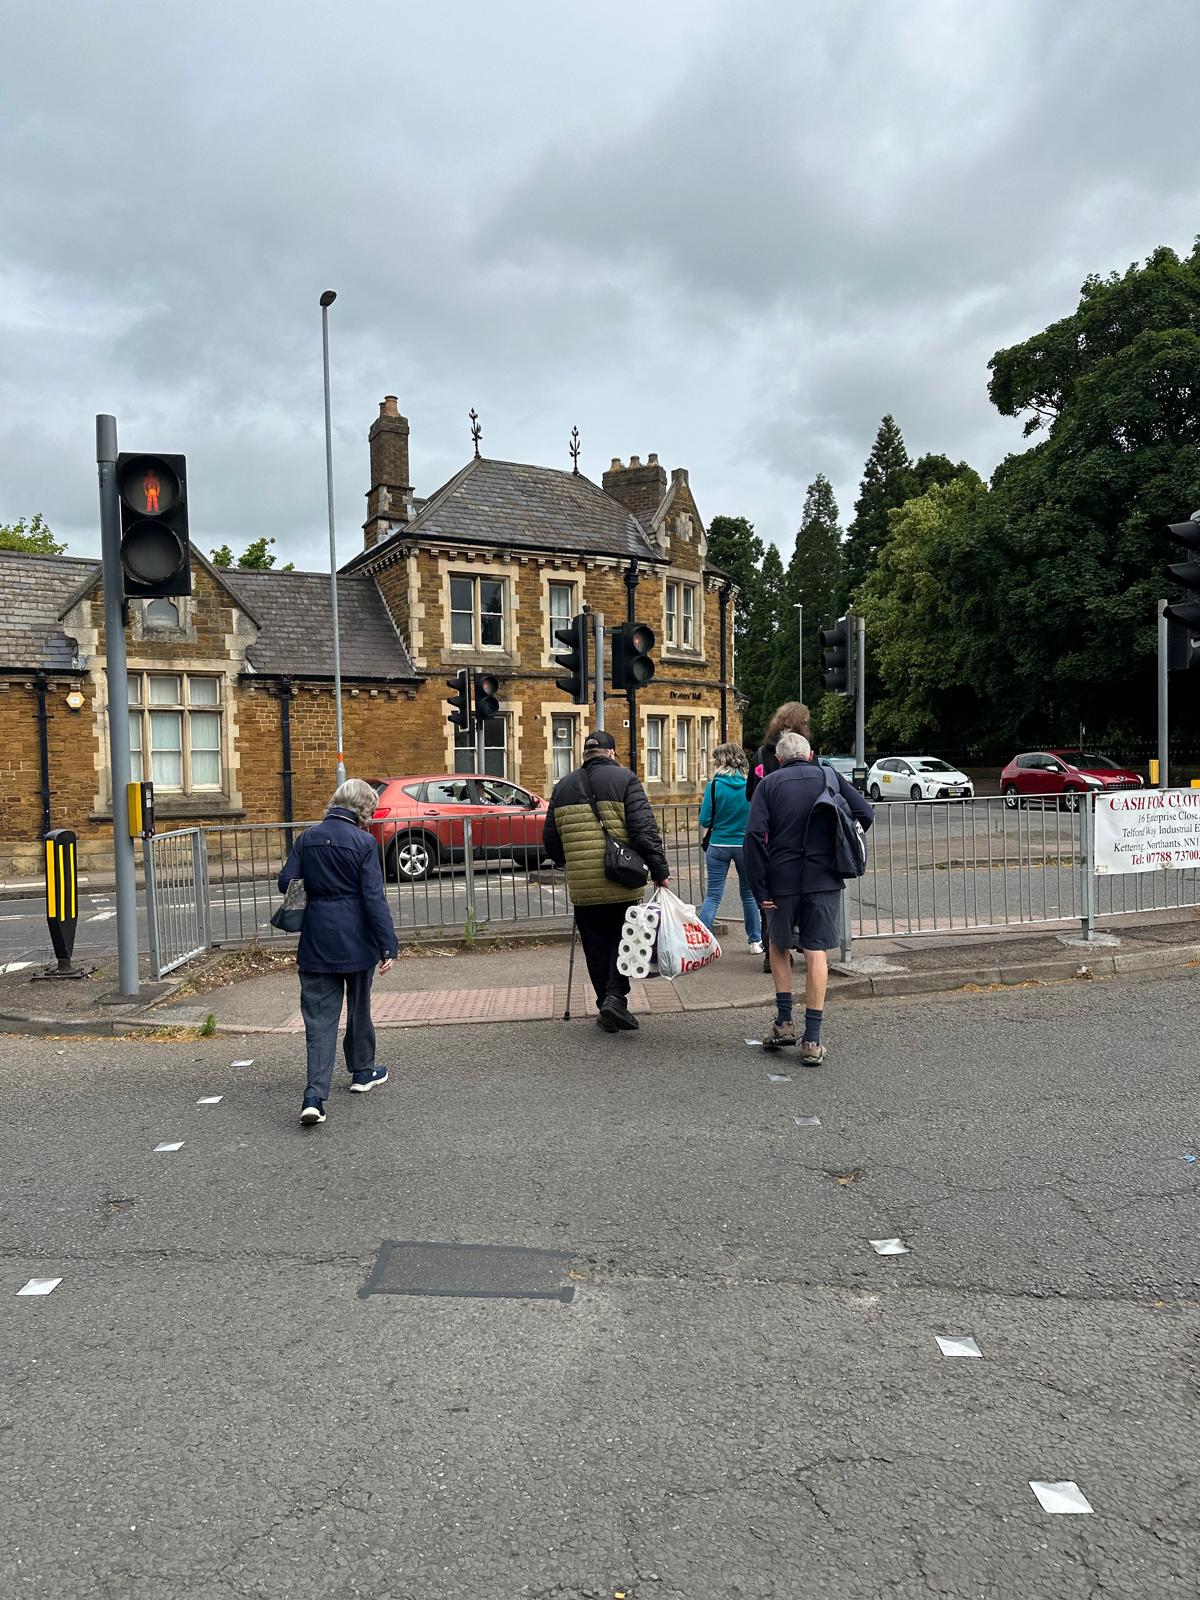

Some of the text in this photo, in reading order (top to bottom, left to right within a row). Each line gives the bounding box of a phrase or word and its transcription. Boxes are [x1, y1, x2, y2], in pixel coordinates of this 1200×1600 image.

[1109, 794, 1200, 811] CASH FOR CLOT
[1138, 814, 1146, 824] 16
[1122, 827, 1145, 838] Telford
[1159, 824, 1193, 835] Industrial
[1194, 823, 1200, 833] E
[1131, 849, 1200, 865] Tel: 07788 73700
